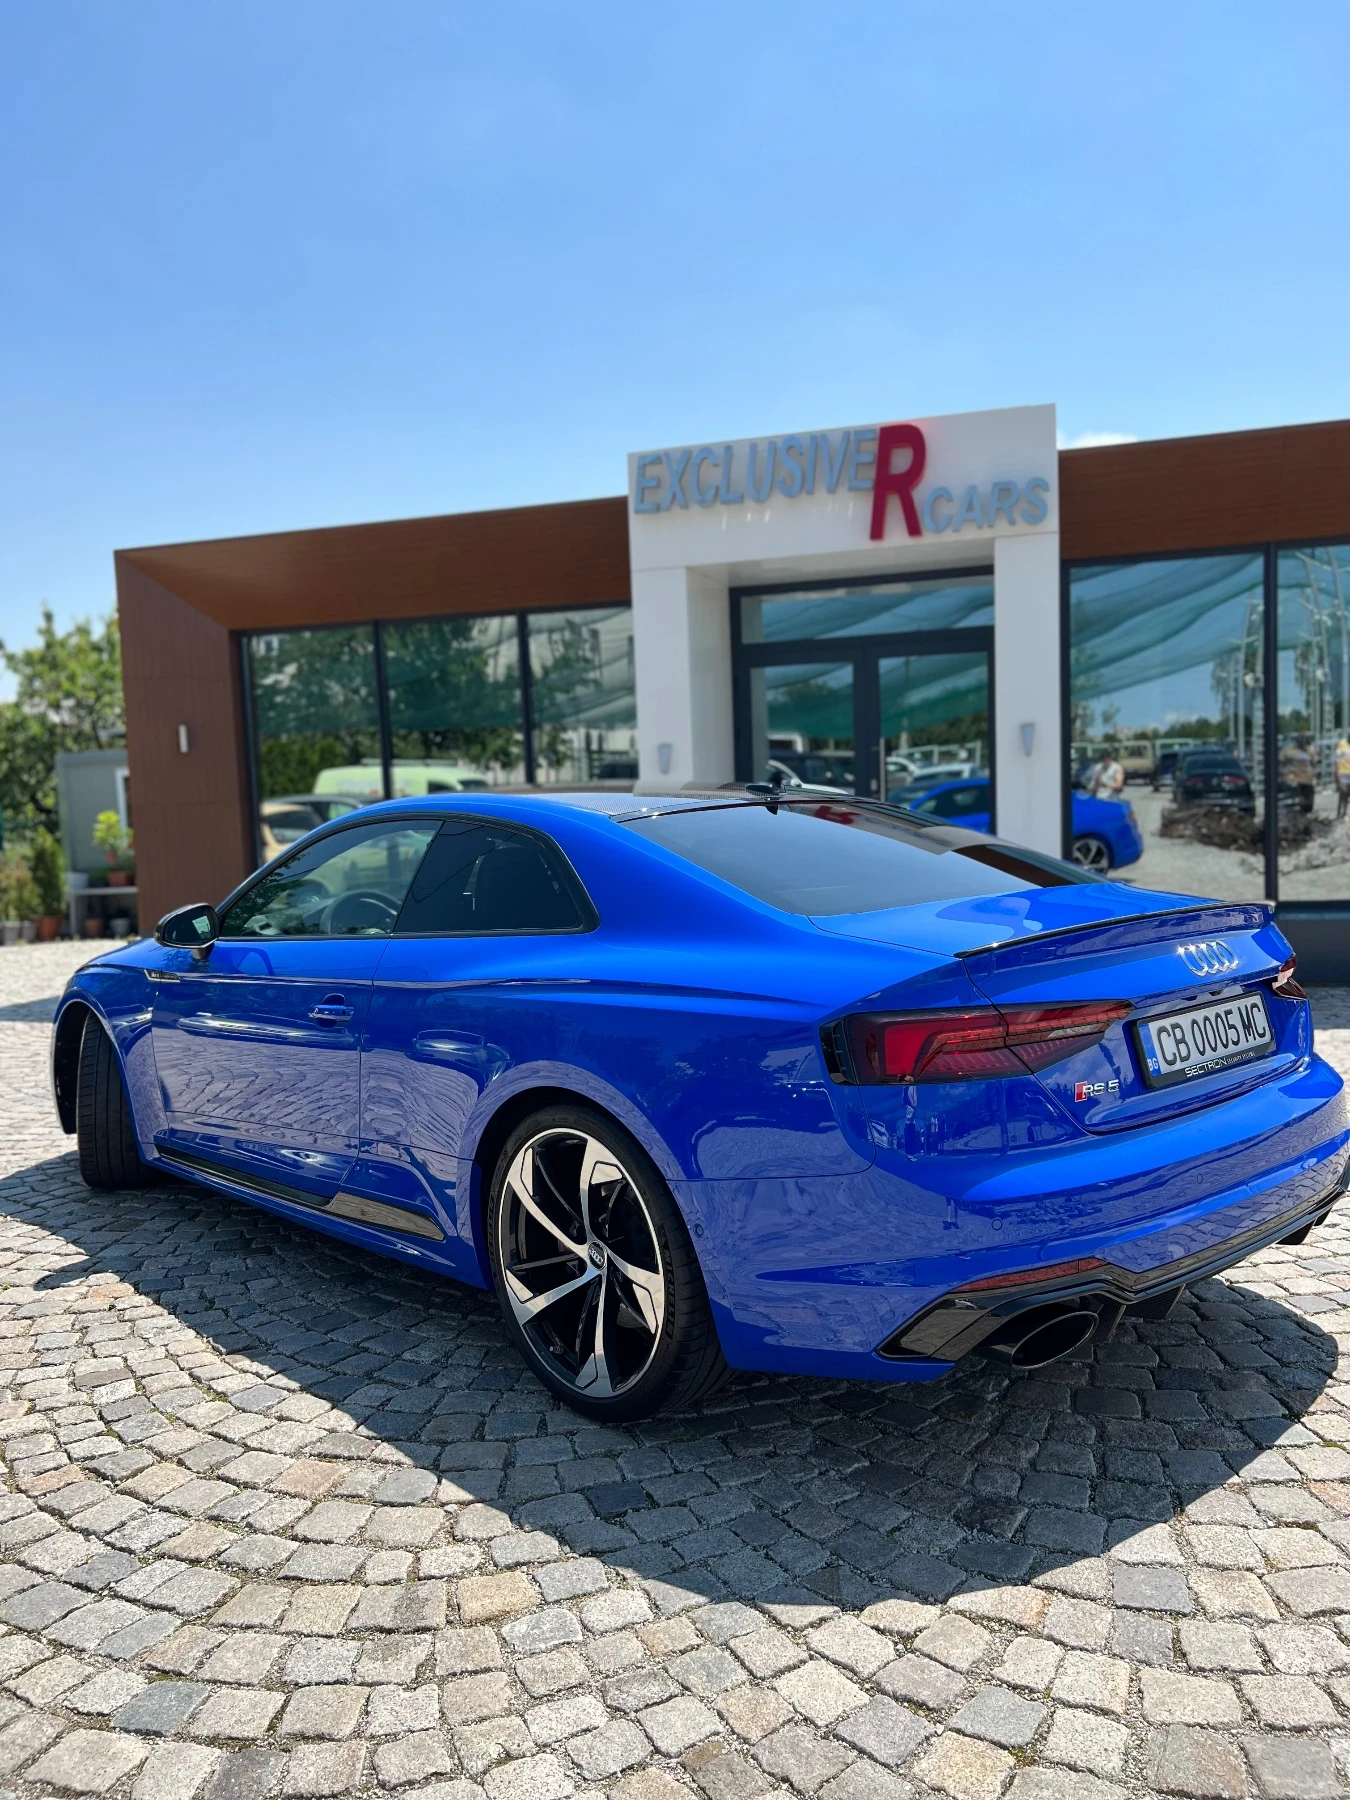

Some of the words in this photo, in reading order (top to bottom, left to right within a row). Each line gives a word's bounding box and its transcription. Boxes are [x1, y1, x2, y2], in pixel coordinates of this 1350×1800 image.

[634, 429, 877, 514] EXCLUSIVE
[869, 423, 926, 541] R
[924, 476, 1050, 534] CARS
[1156, 1021, 1191, 1067] CB
[1190, 1008, 1241, 1057] 0005
[1237, 1001, 1267, 1044] MC
[1147, 1057, 1159, 1071] BG
[1184, 1057, 1228, 1077] SECTRON
[1082, 1082, 1105, 1099] RS
[1107, 1079, 1120, 1093] 5
[664, 1249, 675, 1335] MICHELIN
